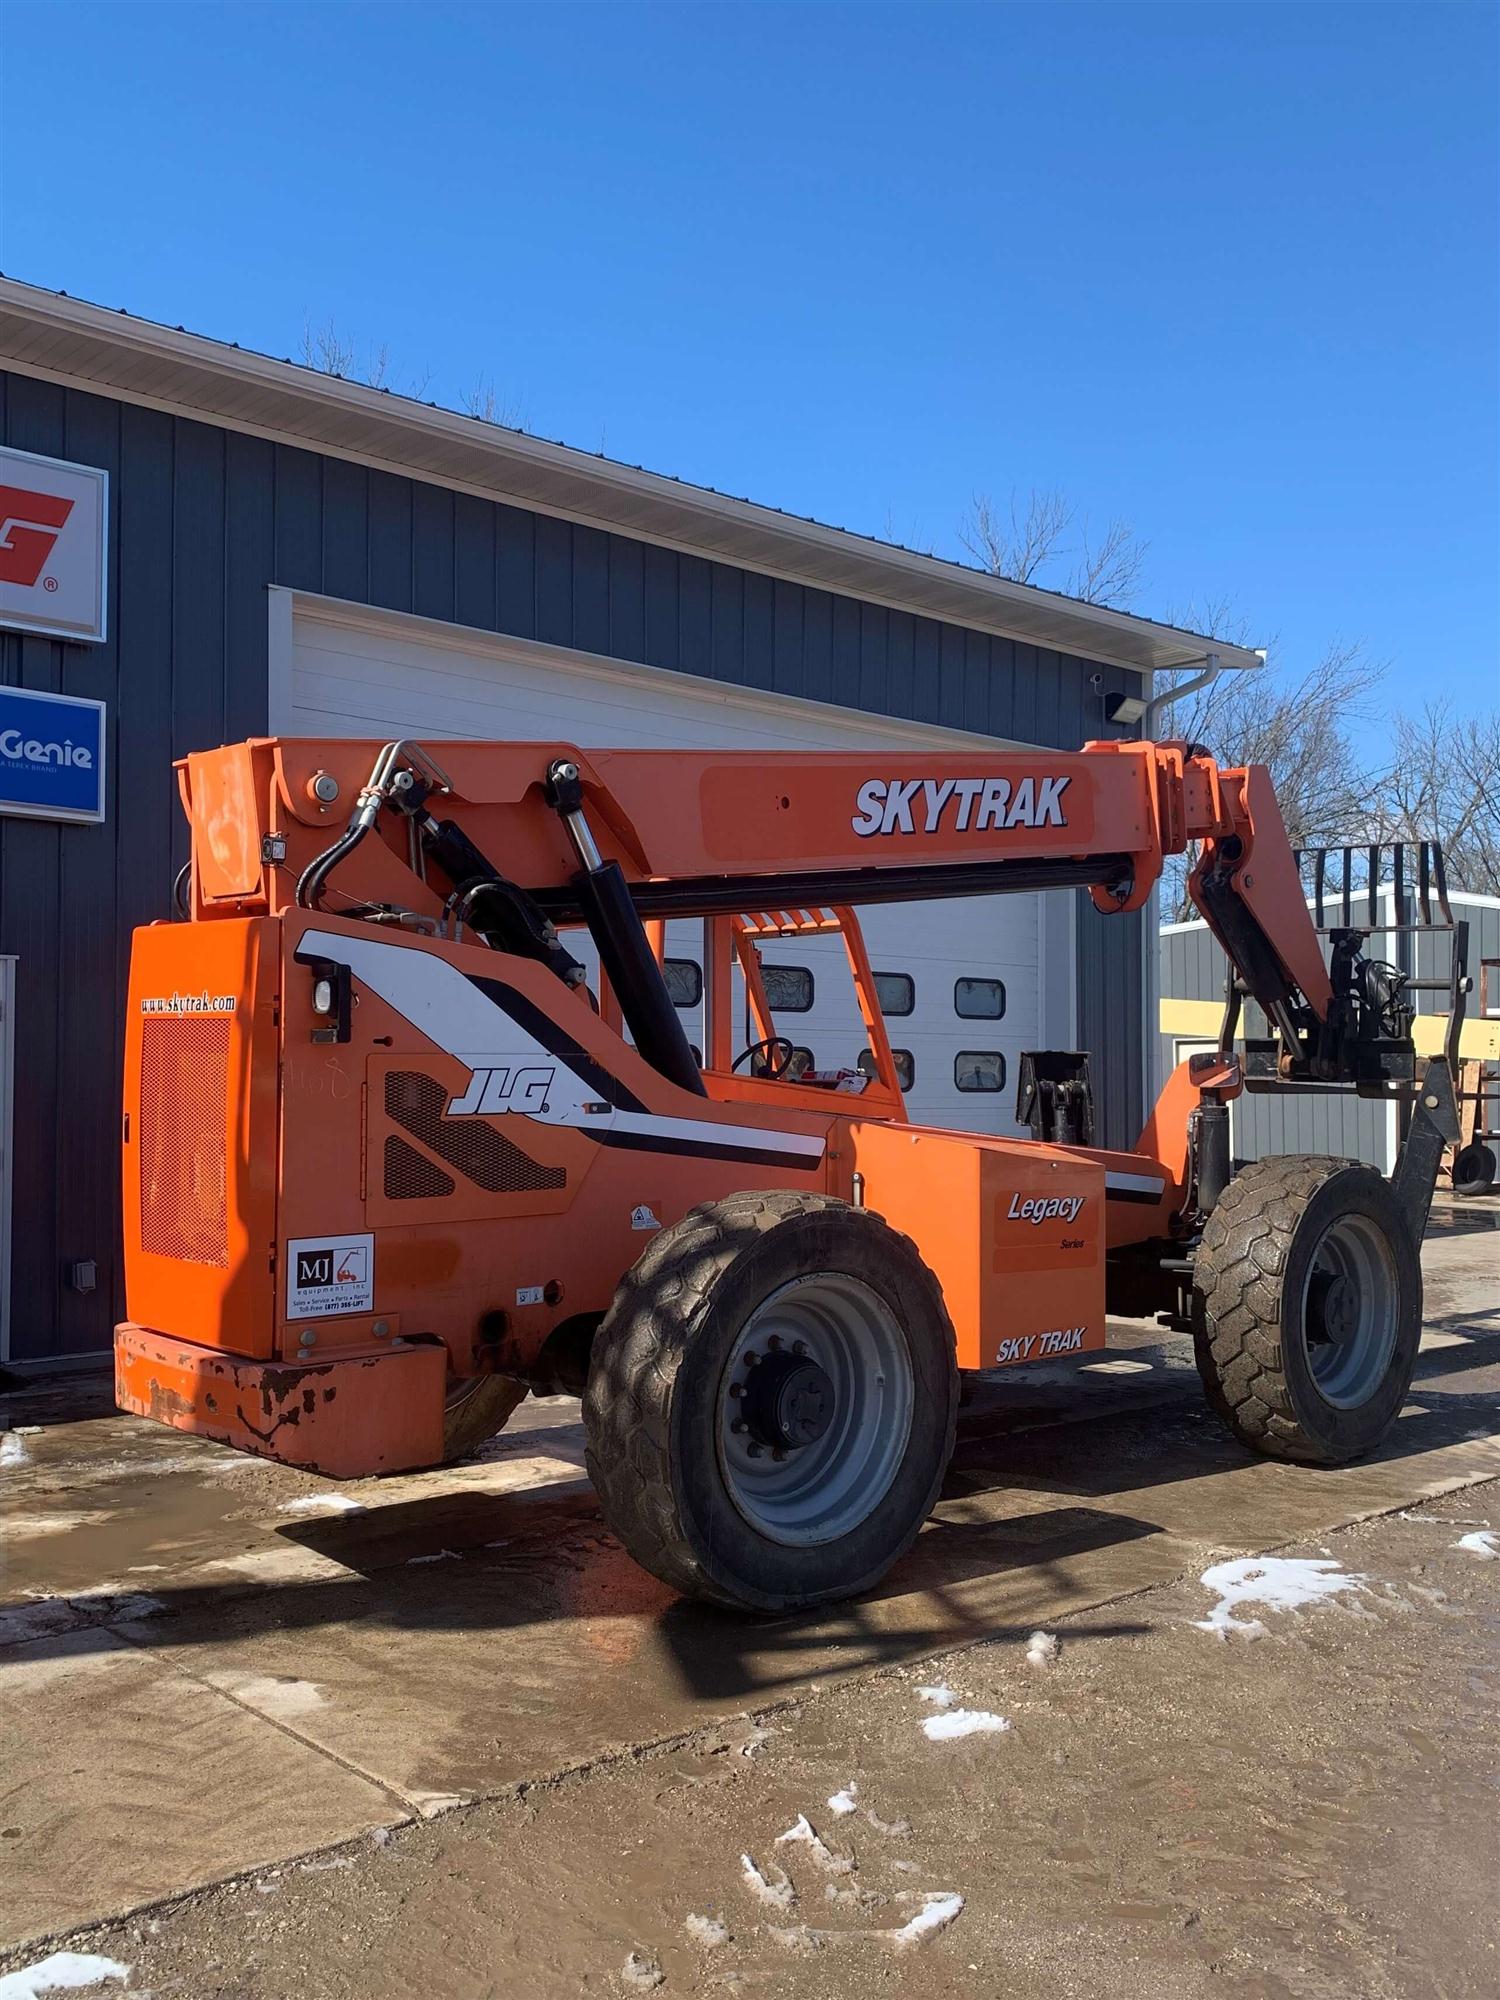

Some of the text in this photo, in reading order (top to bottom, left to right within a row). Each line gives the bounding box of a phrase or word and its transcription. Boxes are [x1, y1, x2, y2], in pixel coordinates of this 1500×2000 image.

[0, 729, 92, 769] Genie
[851, 777, 1071, 838] SKYTRAK
[141, 991, 235, 1017] www.skytrak.com
[446, 1067, 555, 1116] JLG
[1007, 1192, 1087, 1226] Legacy
[1060, 1238, 1085, 1250] Series
[300, 1258, 330, 1283] MJ
[311, 1297, 330, 1305] Service
[996, 1327, 1087, 1363] SKY TRAK
